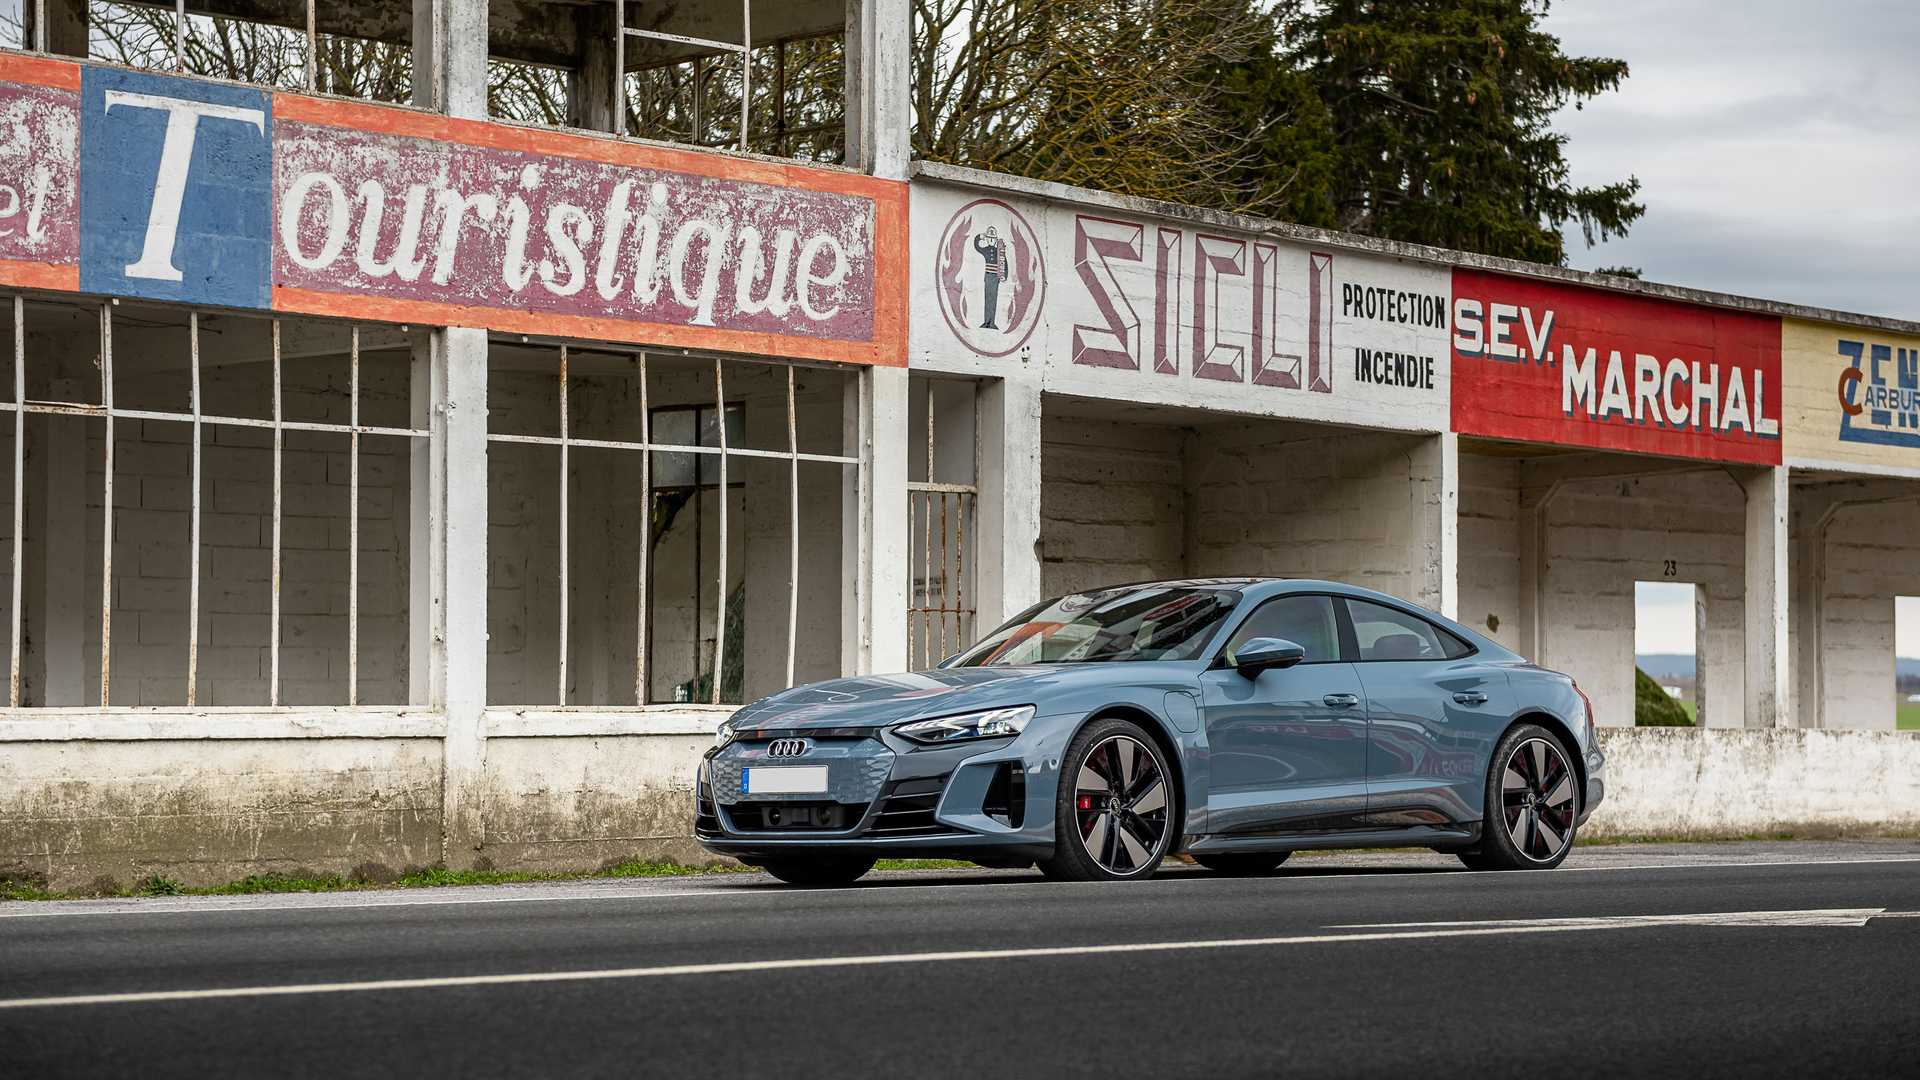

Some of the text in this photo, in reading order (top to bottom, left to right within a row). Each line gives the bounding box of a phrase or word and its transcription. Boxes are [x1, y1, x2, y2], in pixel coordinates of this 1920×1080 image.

[104, 90, 852, 327] Touristique
[1072, 214, 1333, 394] SICLI
[1342, 282, 1446, 330] PROTECTION
[1453, 297, 1557, 366] S.E.V.
[1354, 346, 1435, 390] INCENDIE
[1562, 343, 1779, 438] MARCHAL
[1663, 559, 1677, 577] 23
